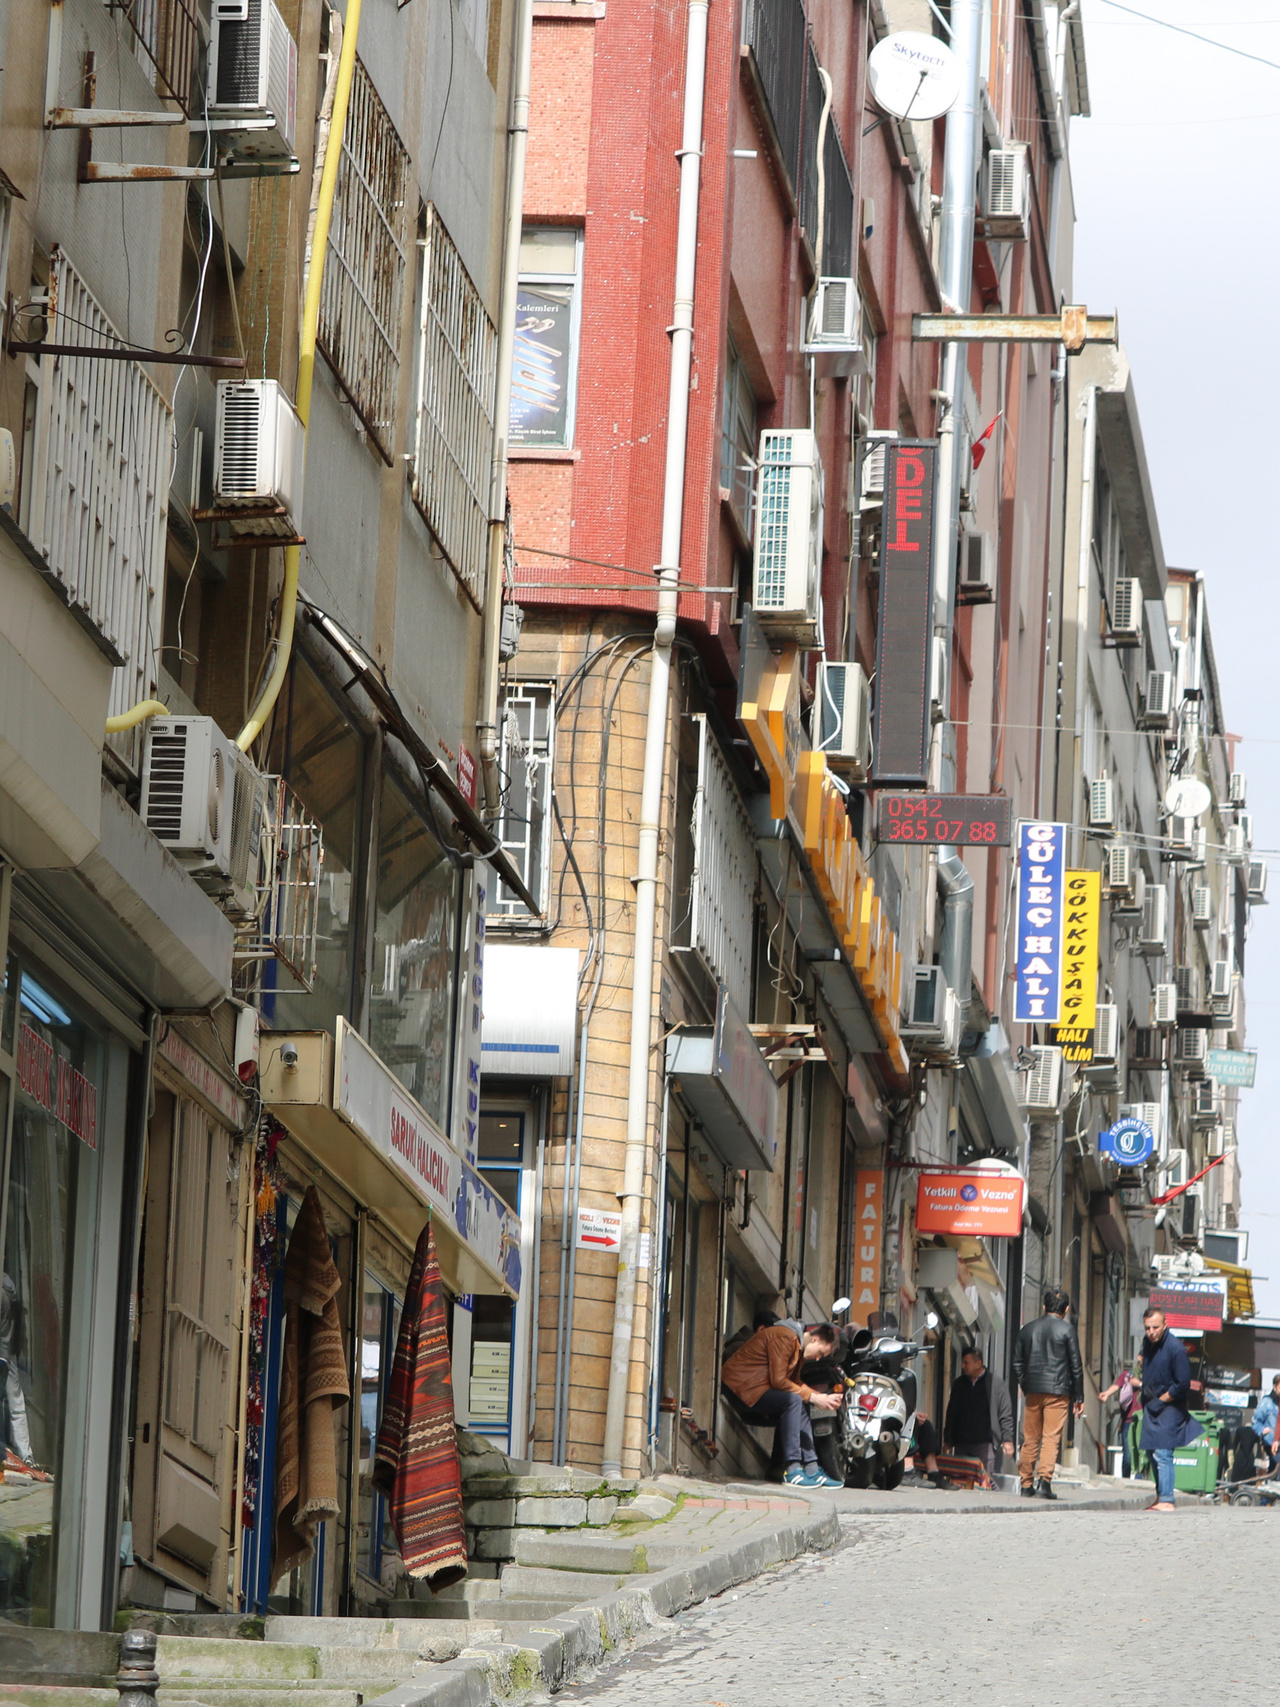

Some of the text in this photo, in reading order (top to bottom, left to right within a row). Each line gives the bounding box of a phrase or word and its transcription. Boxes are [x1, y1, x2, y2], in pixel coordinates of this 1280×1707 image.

[893, 43, 945, 66] Skytech
[888, 798, 943, 818] 0542
[888, 819, 997, 842] 365 07 88
[1022, 825, 1056, 1017] GÜLEÇ HALI
[1063, 878, 1089, 1026] GÖKKUŞAĞI
[1056, 1029, 1089, 1043] HALI
[1062, 1045, 1093, 1062] İLİM
[924, 1186, 957, 1198] Yetkili
[930, 1203, 1009, 1214] Fatura Ödeme Veznesi
[858, 1183, 877, 1304] FATURA
